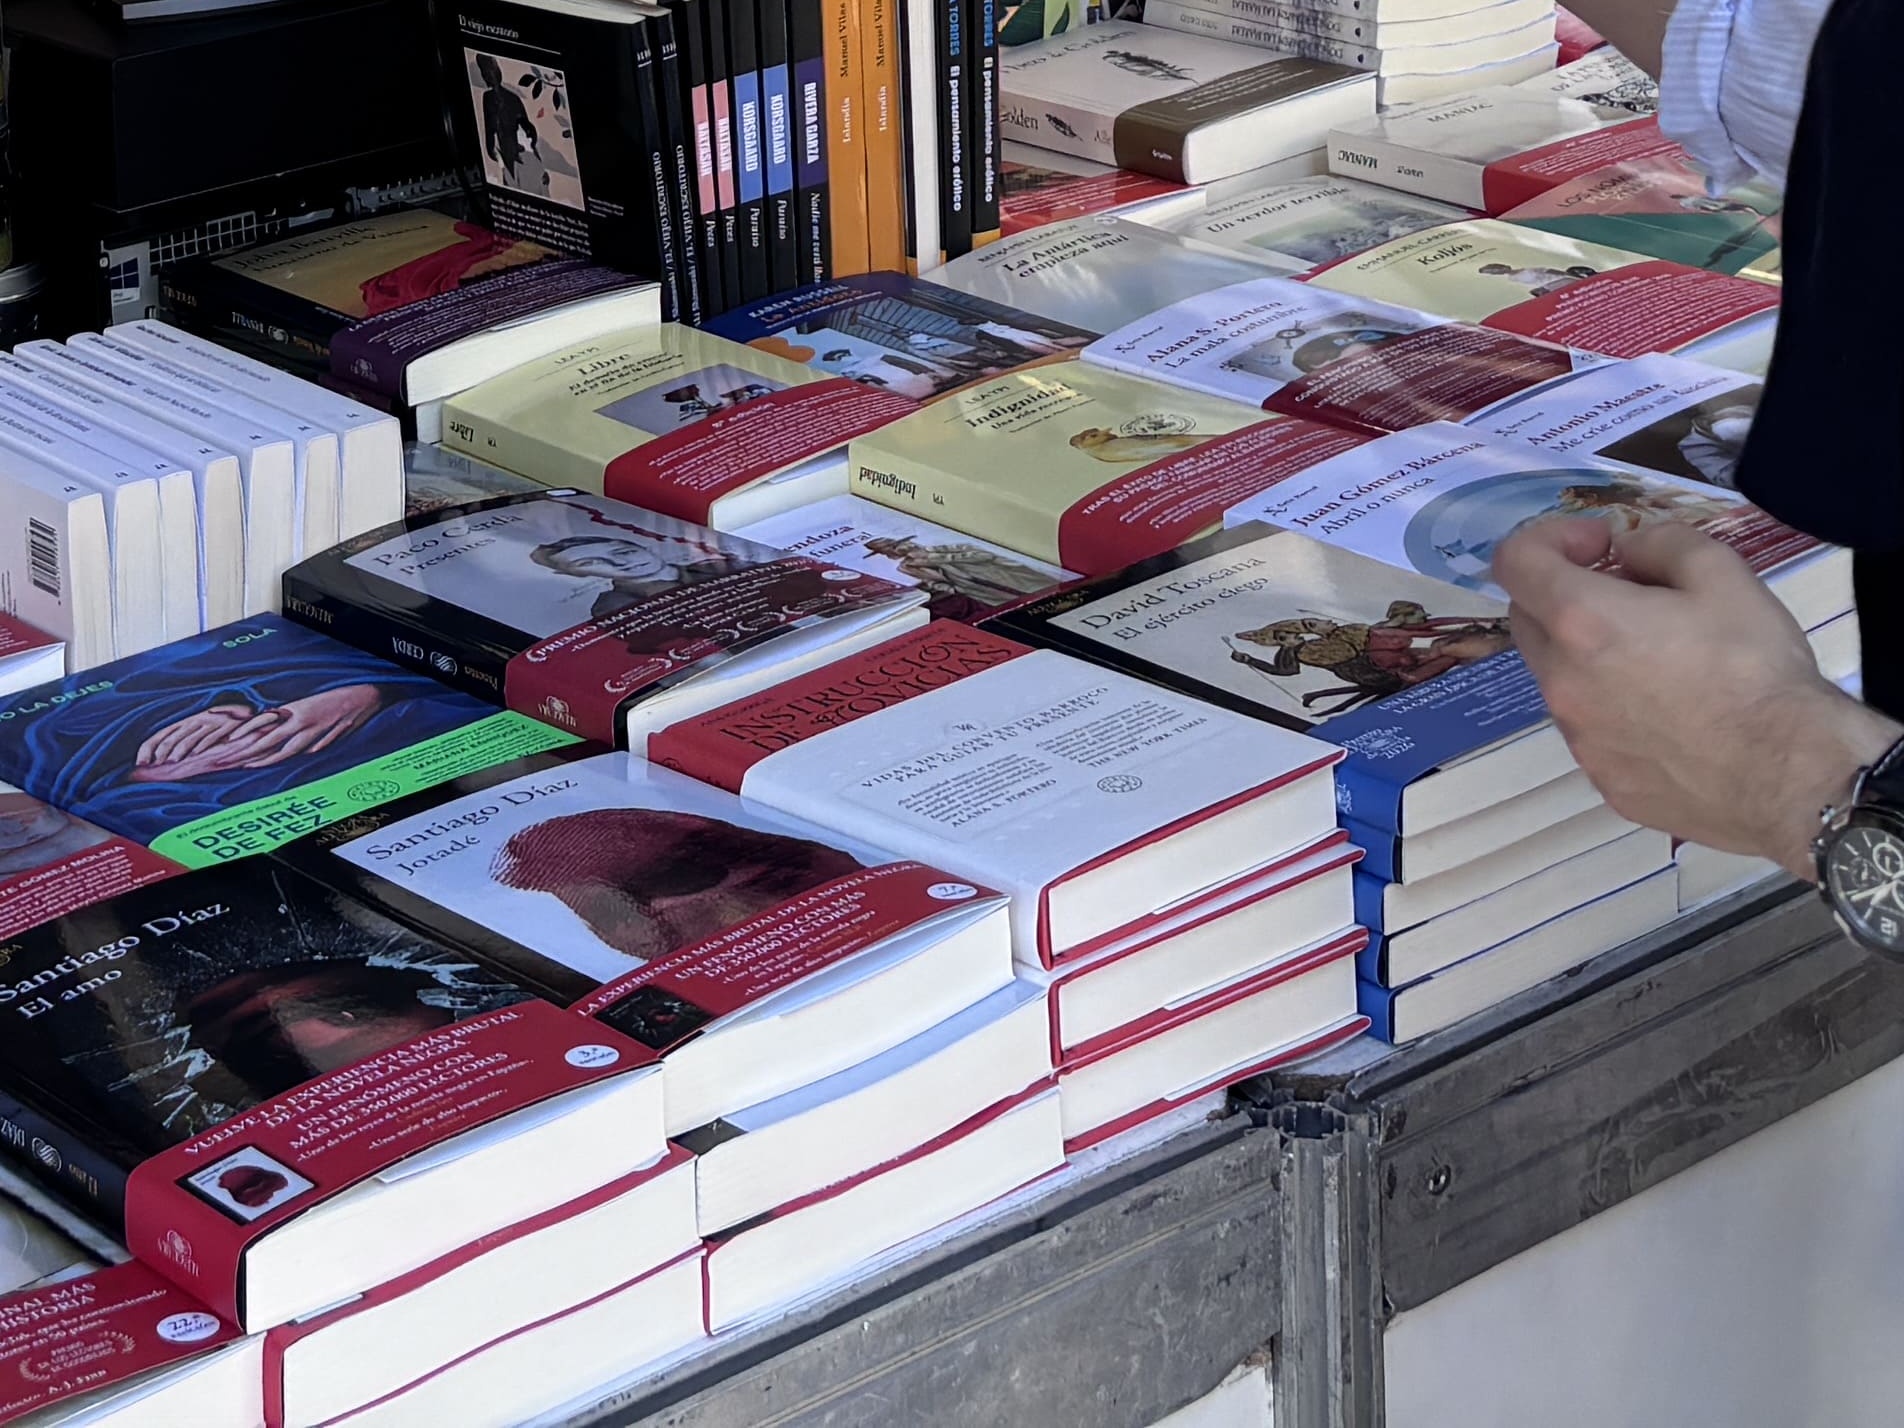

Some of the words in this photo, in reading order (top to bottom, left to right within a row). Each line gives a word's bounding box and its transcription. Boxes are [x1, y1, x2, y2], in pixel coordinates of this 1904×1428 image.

[1082, 595, 1164, 640] David
[1165, 552, 1269, 609] Toscana
[366, 800, 502, 864] Santiago
[510, 776, 579, 808] Díaz
